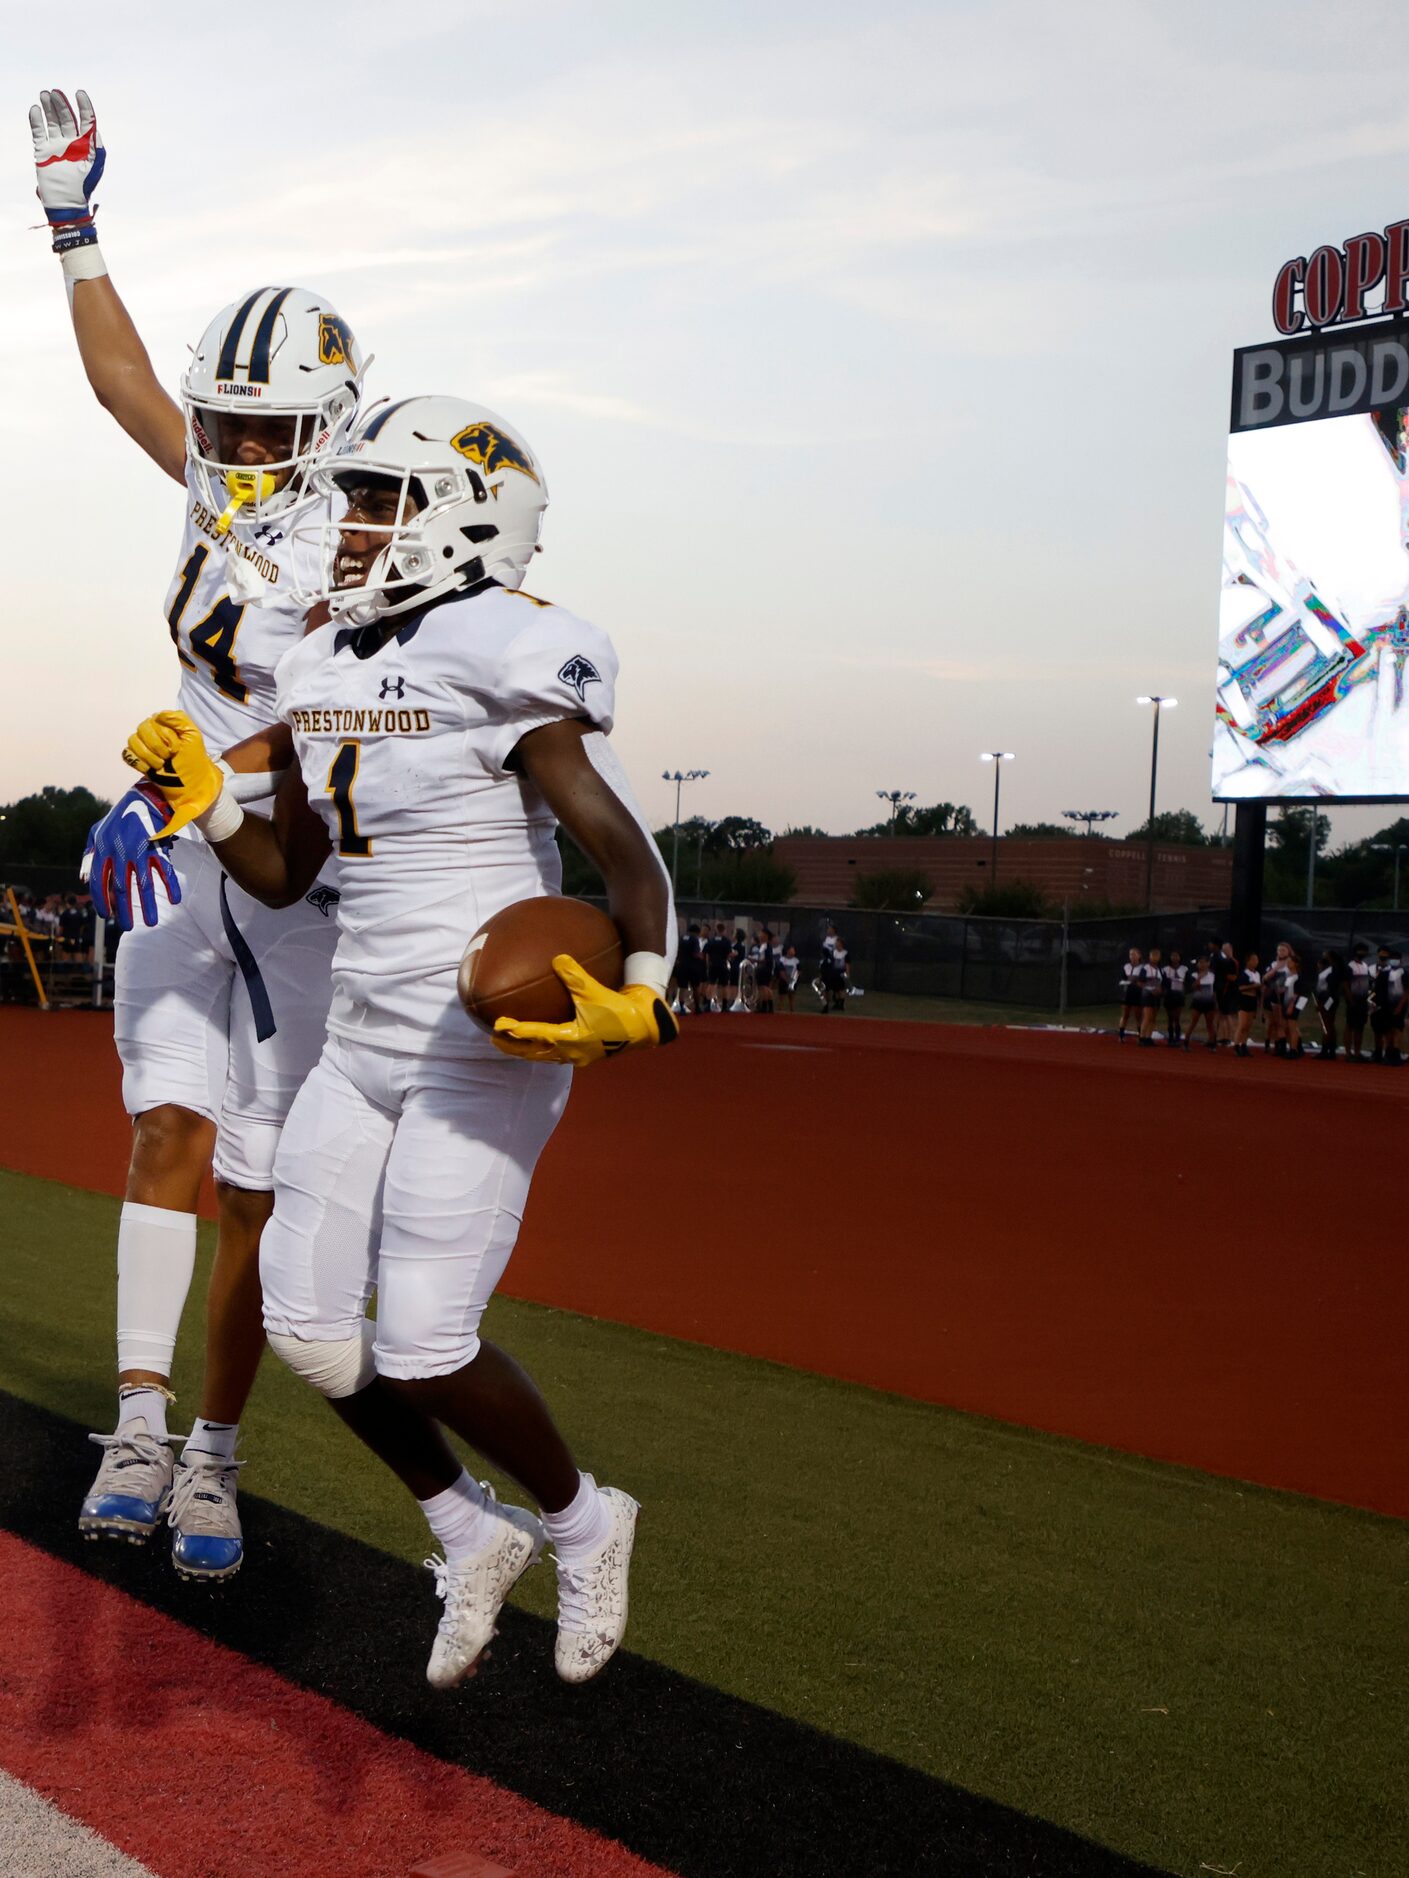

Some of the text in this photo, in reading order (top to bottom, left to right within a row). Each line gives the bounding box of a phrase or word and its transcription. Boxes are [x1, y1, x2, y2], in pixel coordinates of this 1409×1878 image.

[1239, 341, 1409, 426] BUDD
[167, 541, 250, 707] 14
[292, 708, 430, 732] PRESTONWOOD
[324, 738, 374, 858] 1
